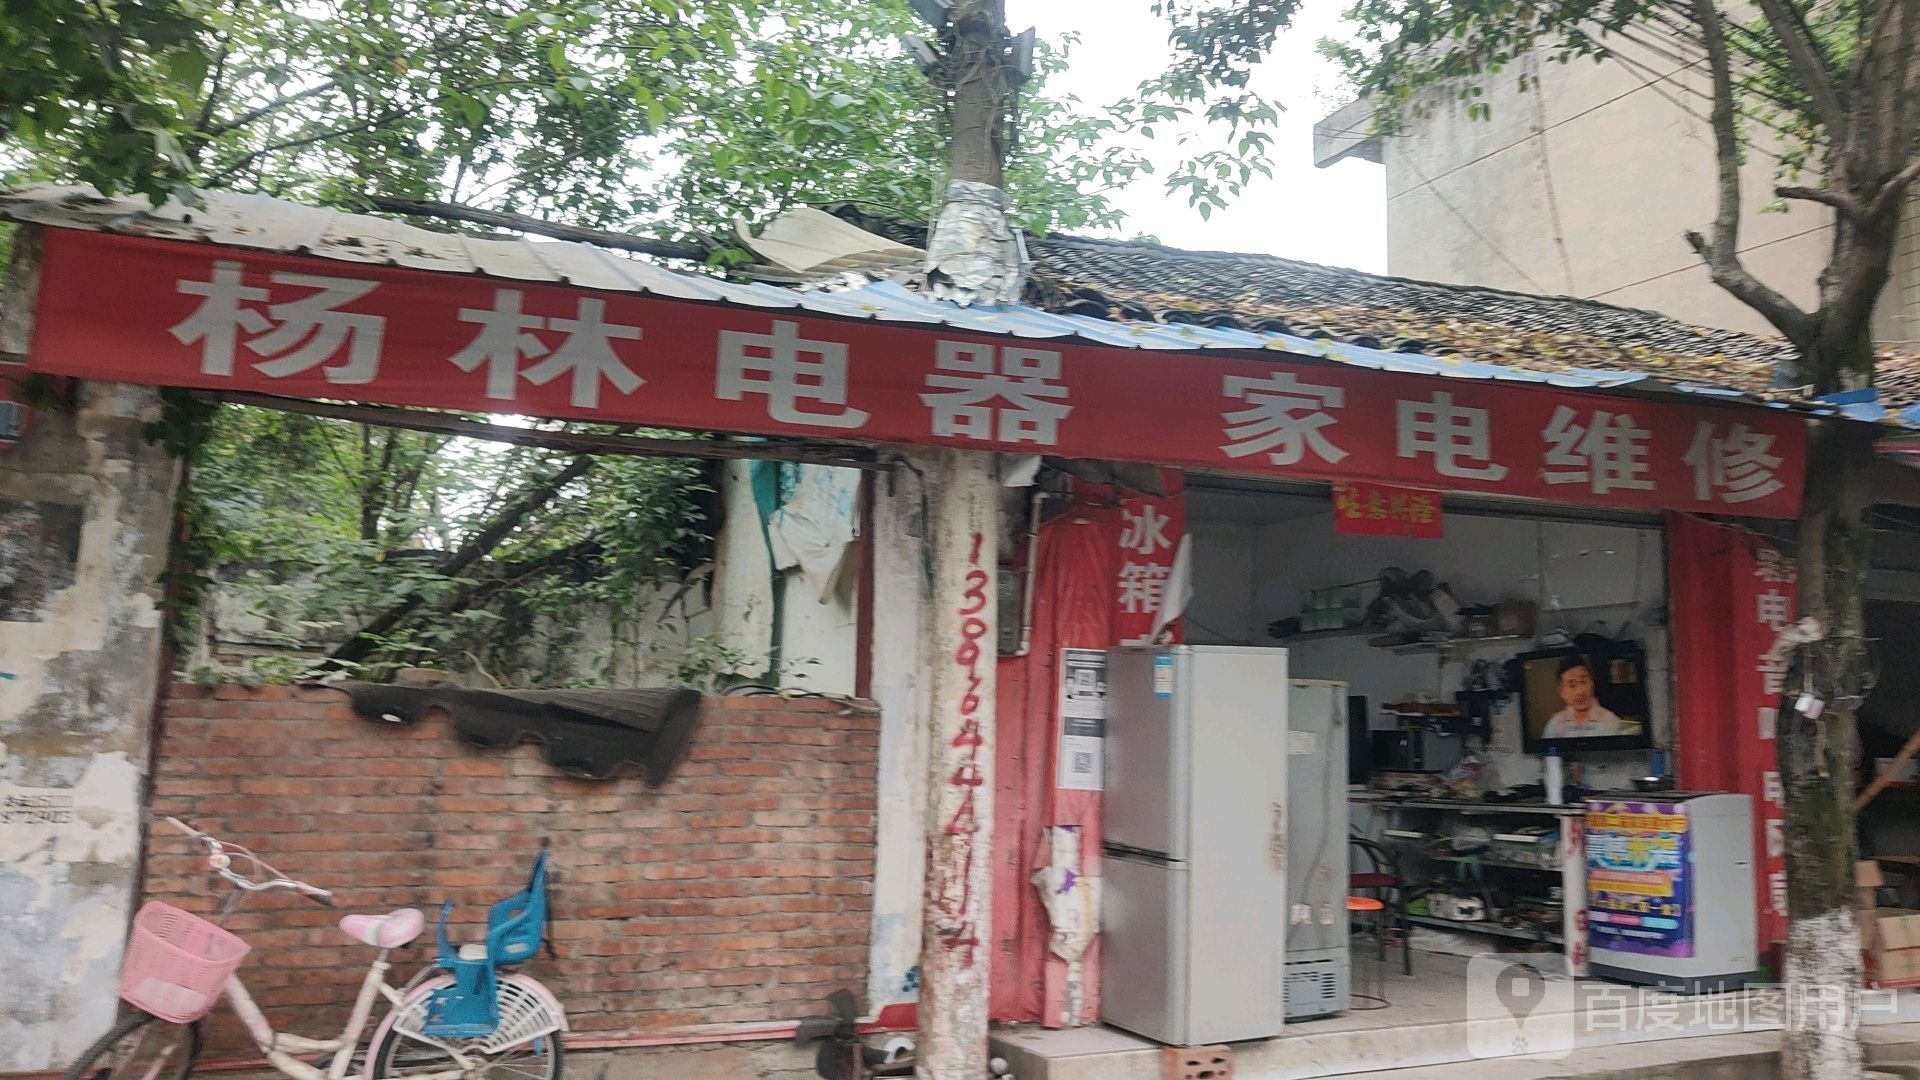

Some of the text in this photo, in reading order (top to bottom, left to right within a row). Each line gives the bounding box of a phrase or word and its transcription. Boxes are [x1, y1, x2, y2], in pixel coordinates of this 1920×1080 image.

[171, 259, 1785, 504] 杨林电器 家电维修
[1116, 504, 1174, 648] 冰箱
